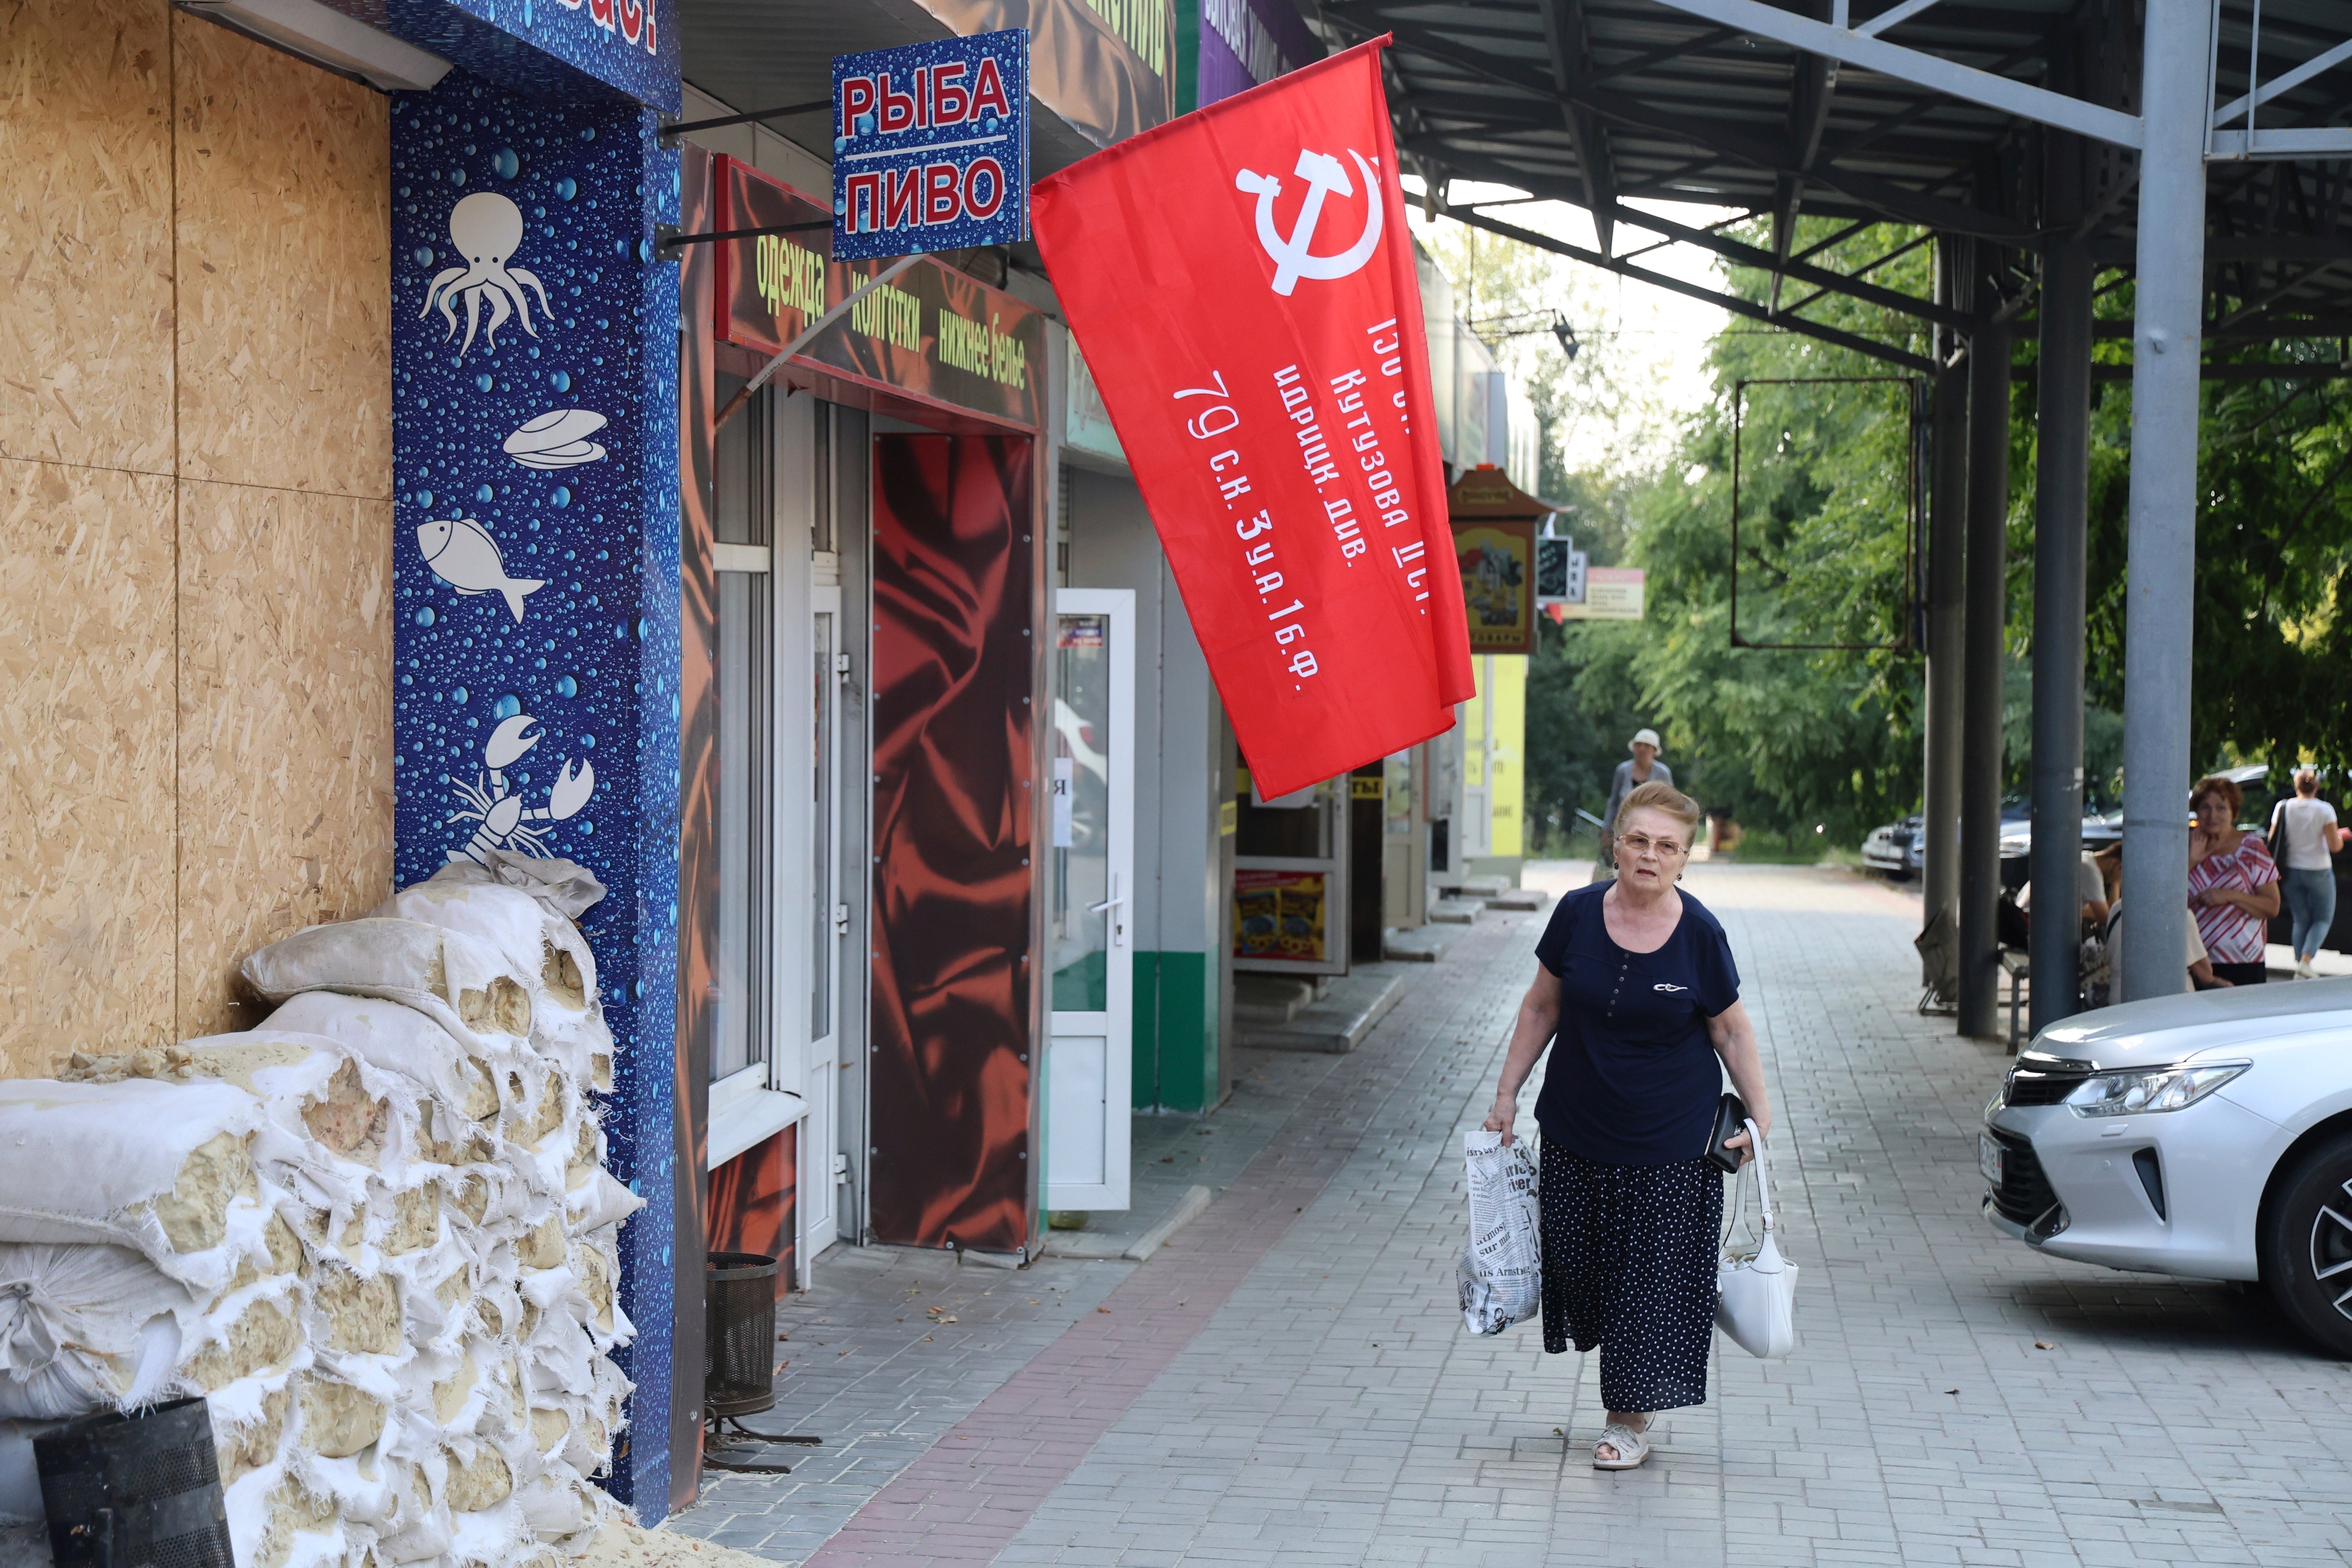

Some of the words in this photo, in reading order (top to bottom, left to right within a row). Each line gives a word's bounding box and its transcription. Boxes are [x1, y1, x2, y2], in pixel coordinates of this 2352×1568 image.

[842, 57, 1011, 139] РЫБА
[845, 156, 1005, 234] ПИВО
[757, 235, 825, 327] одежда
[852, 271, 920, 353] колготки
[939, 309, 988, 377] нижнее
[992, 312, 1025, 390] белье
[1173, 370, 1240, 439] 79
[1479, 1243, 1497, 1257] sur
